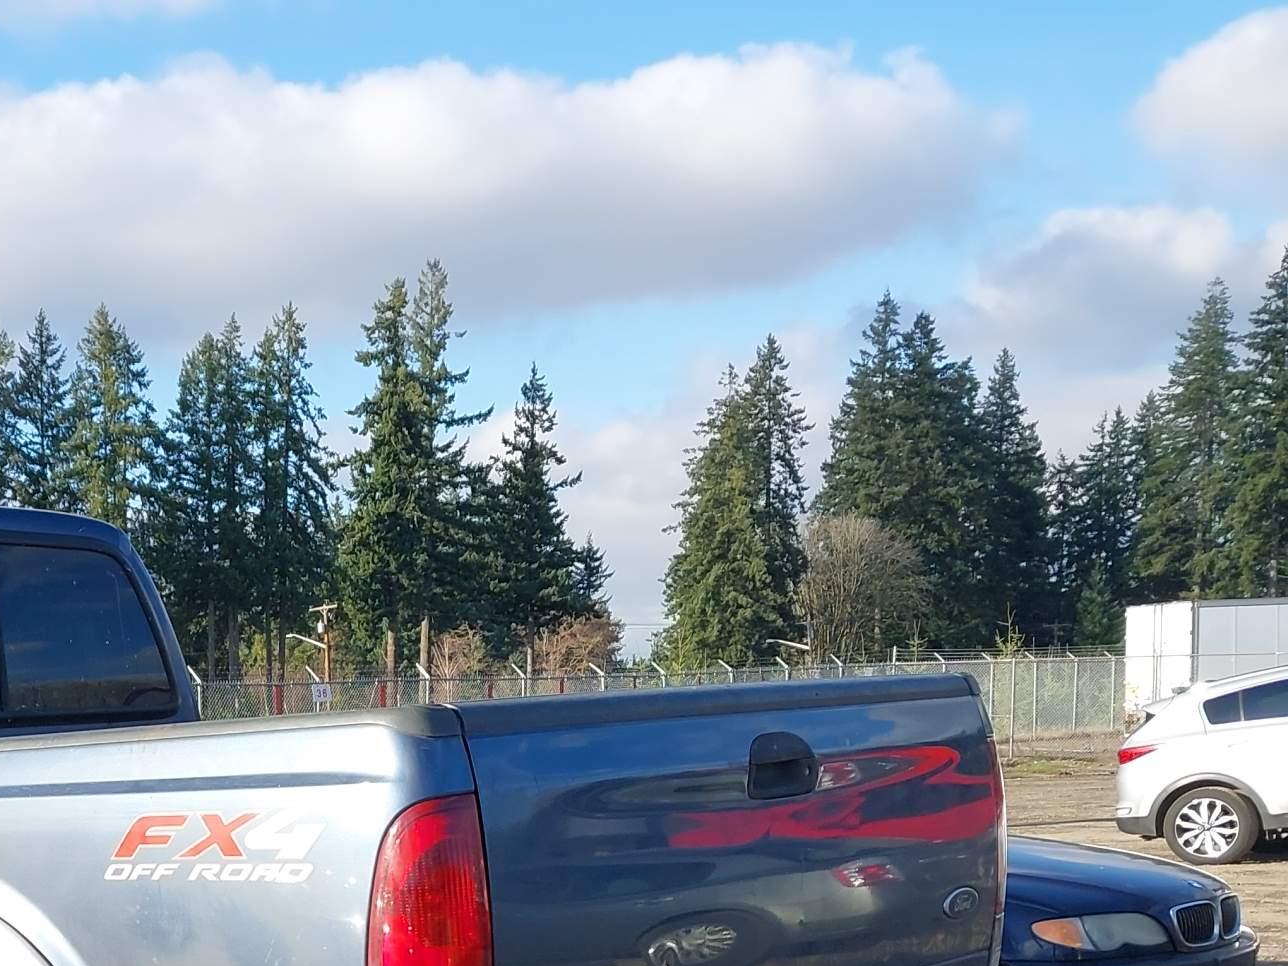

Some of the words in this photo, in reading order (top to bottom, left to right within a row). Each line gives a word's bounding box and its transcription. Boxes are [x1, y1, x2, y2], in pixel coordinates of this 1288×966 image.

[112, 808, 327, 861] FX4
[103, 863, 180, 881] OFF
[187, 863, 314, 883] ROAD
